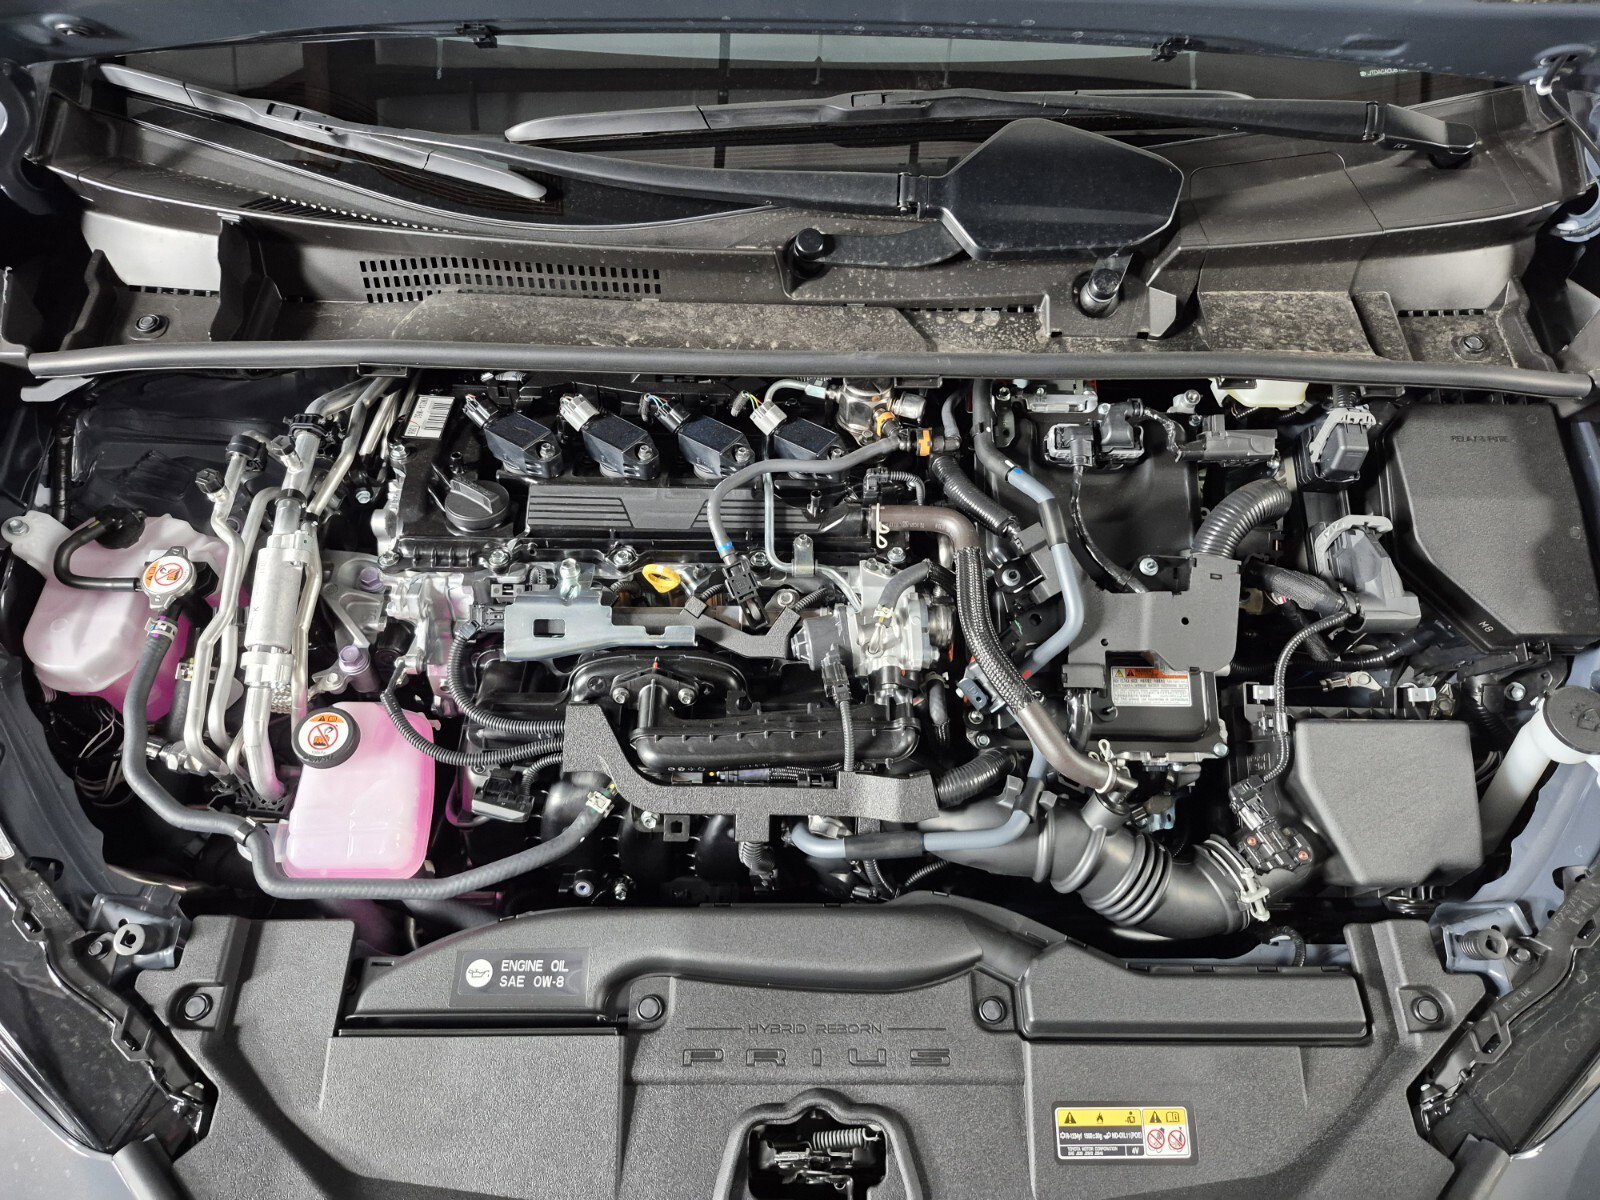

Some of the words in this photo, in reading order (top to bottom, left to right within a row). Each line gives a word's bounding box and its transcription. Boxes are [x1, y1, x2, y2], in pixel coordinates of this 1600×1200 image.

[501, 959, 544, 972] ENGINE
[550, 959, 569, 973] OIL
[499, 975, 526, 988] SAE
[533, 975, 565, 988] 0W-8
[749, 1023, 807, 1035] HYBRID
[815, 1023, 882, 1035] REBORN
[682, 1048, 951, 1067] PRIUS
